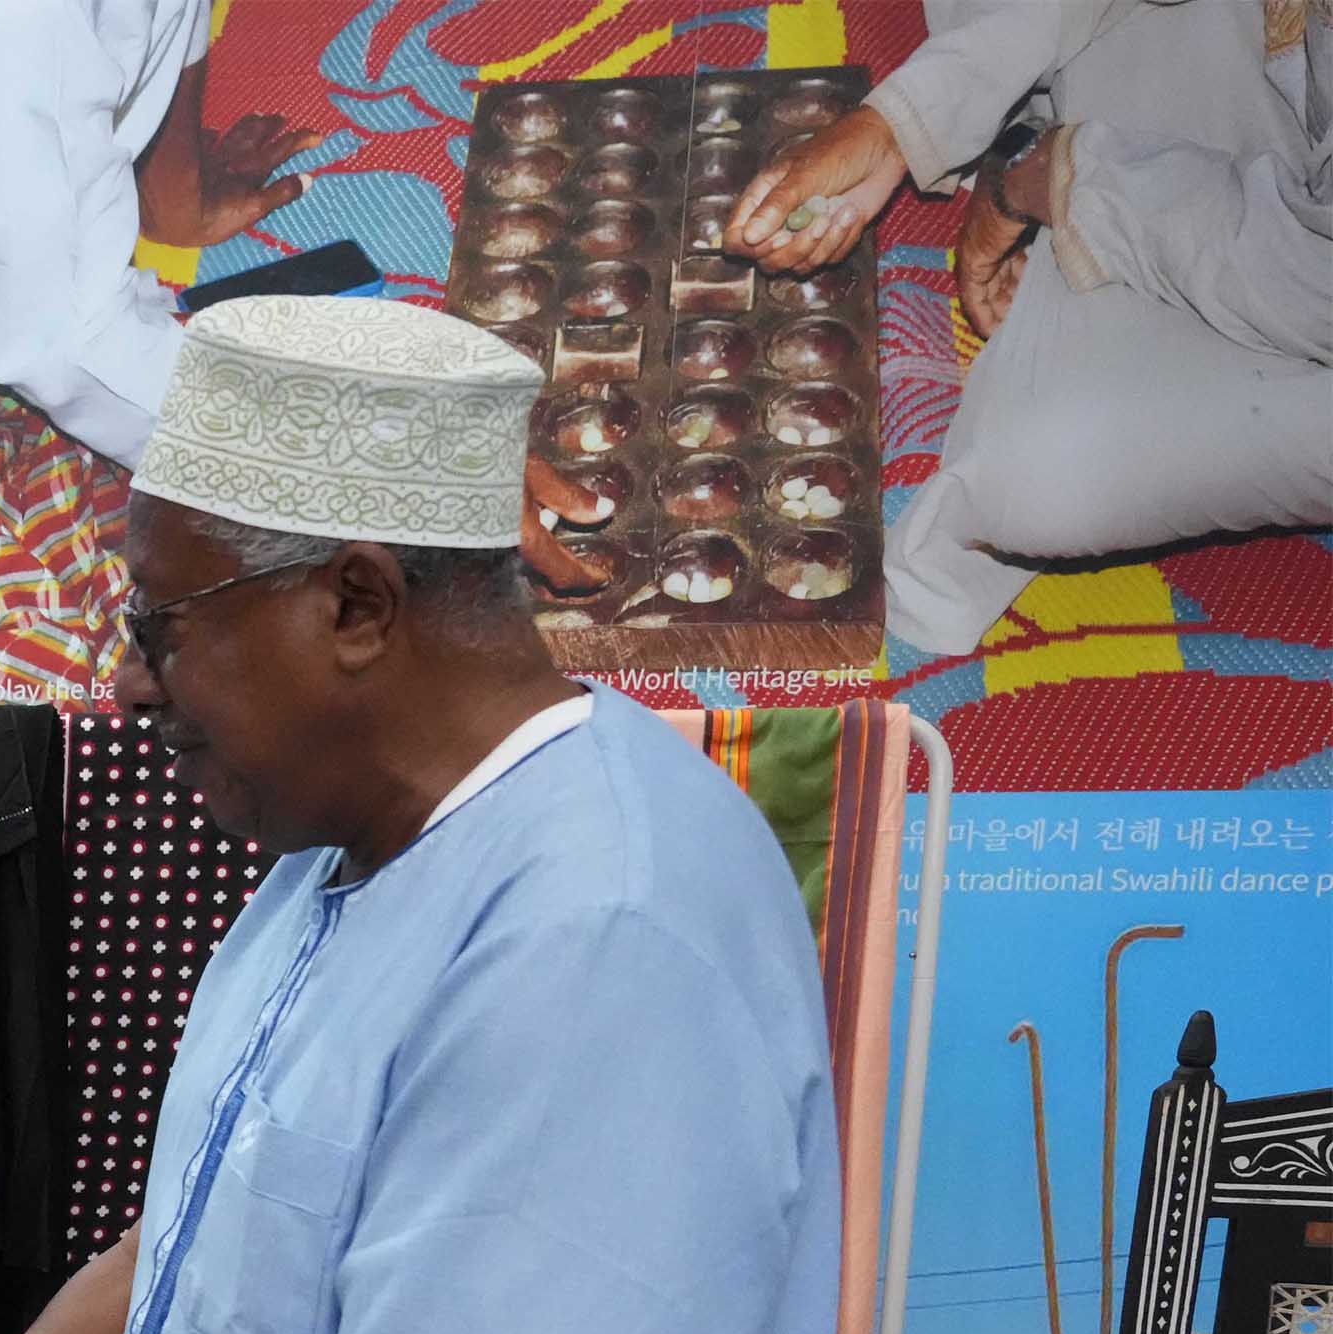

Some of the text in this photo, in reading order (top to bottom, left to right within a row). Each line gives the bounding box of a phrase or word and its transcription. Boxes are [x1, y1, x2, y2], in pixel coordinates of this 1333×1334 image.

[45, 677, 84, 701] the
[91, 676, 115, 700] ba
[619, 665, 697, 692] World
[705, 664, 819, 694] Heritage
[825, 662, 872, 688] site
[948, 818, 1079, 852] 마을에서
[1094, 817, 1161, 851] 전해
[1175, 816, 1315, 851] 내려오는
[958, 867, 1103, 892] traditional
[1111, 867, 1214, 892] Swahili
[1220, 867, 1310, 892] dance
